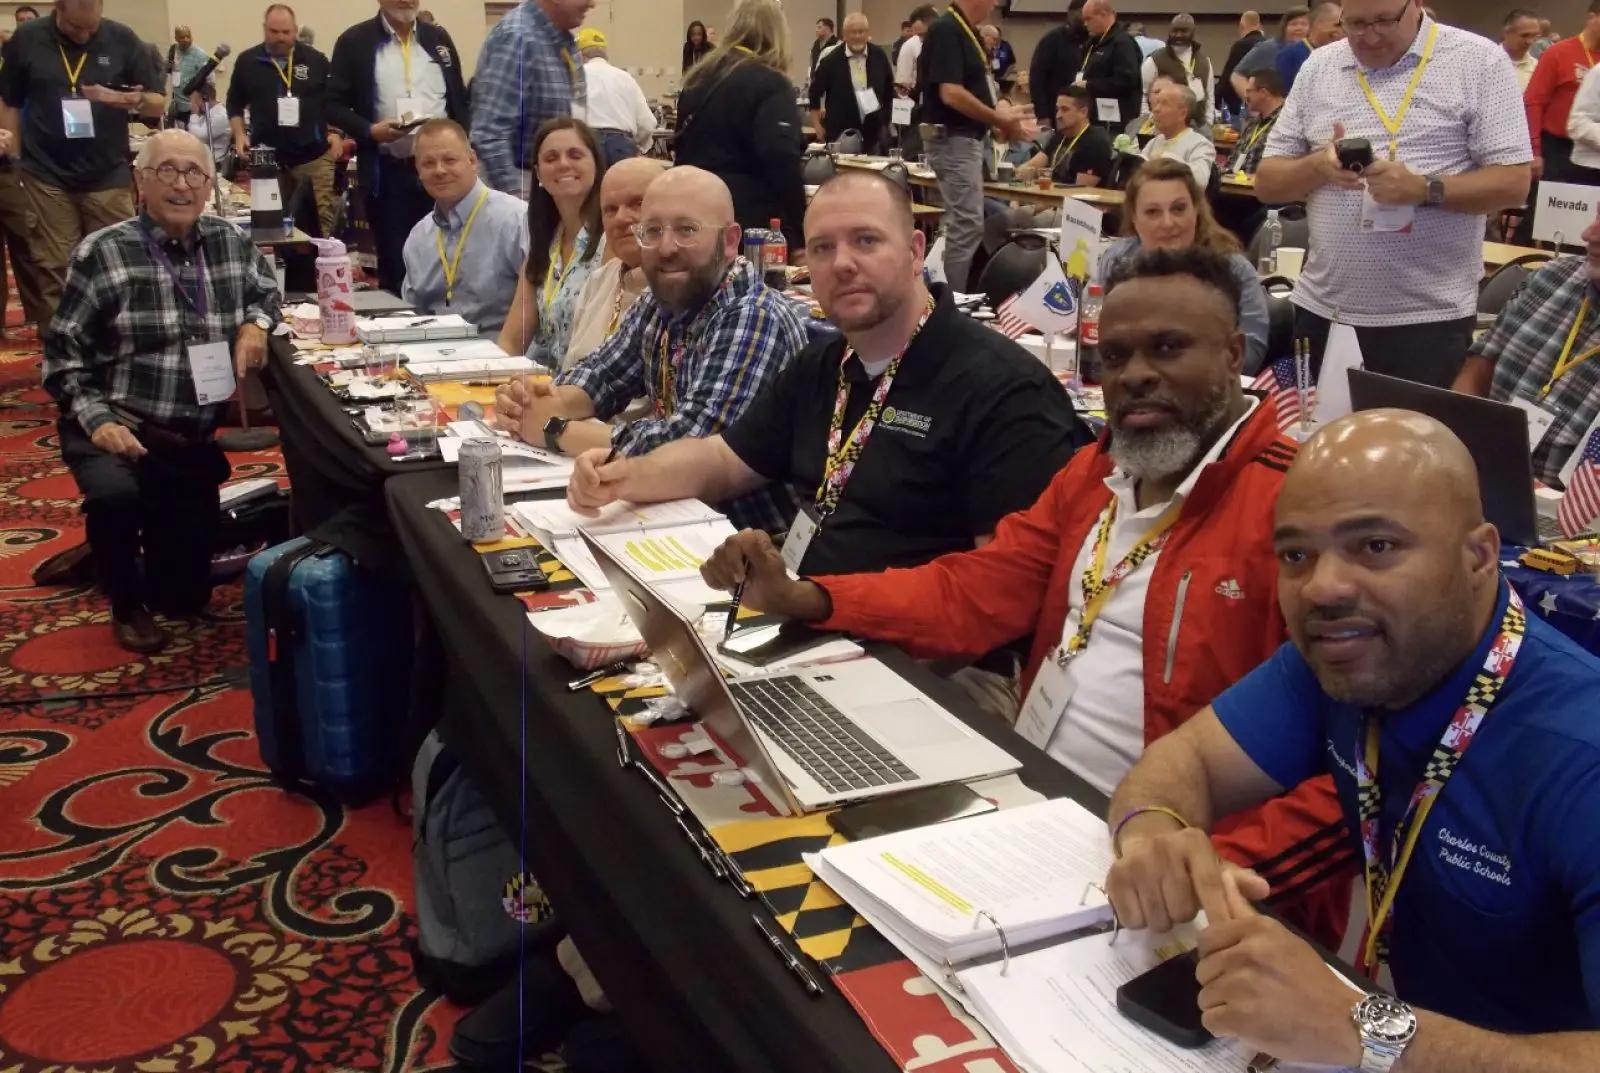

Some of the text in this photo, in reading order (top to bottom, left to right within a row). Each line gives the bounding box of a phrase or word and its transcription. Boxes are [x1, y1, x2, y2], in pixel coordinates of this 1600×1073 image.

[1548, 196, 1588, 212] Nevada
[1215, 585, 1245, 600] adidas
[1439, 828, 1511, 872] Charles County
[1439, 847, 1512, 886] Public Schools
